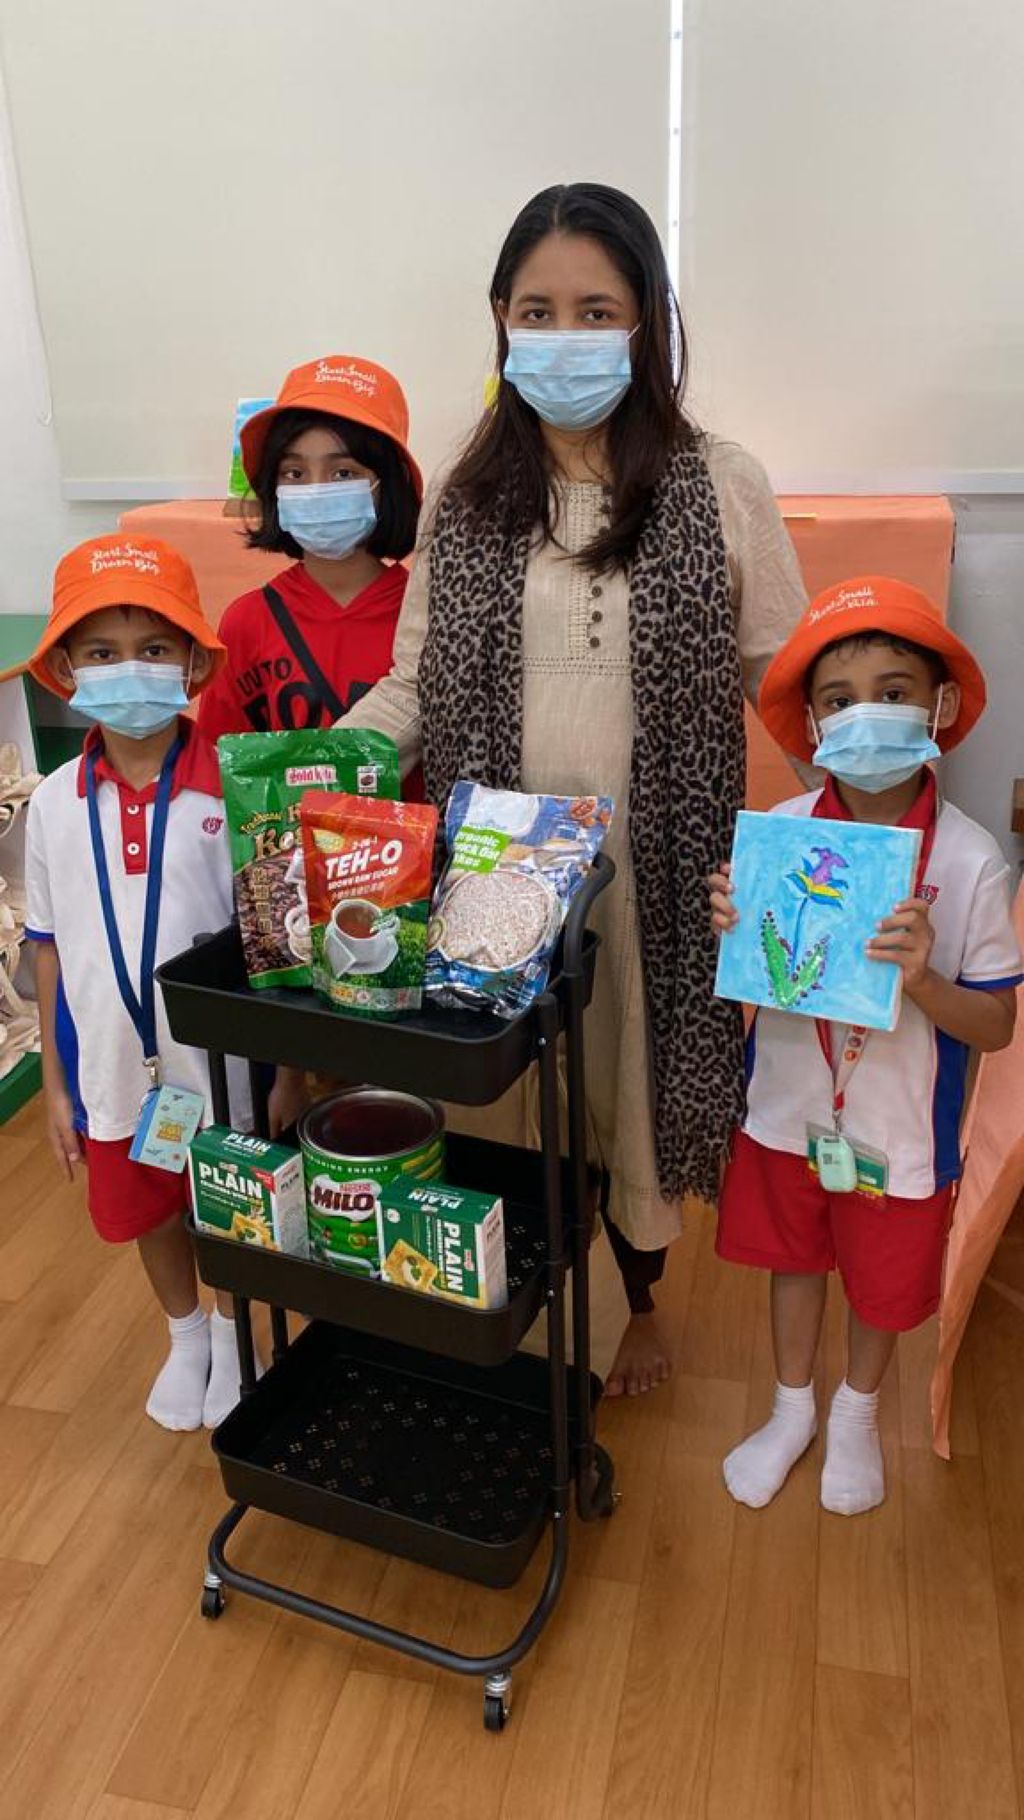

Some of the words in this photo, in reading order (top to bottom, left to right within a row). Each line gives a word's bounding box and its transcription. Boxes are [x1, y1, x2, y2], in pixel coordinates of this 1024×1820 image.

[325, 839, 403, 881] TEH-O
[225, 1132, 271, 1152] PLAIN
[199, 1162, 262, 1198] PLAIN
[347, 1165, 389, 1174] ENERGY
[314, 1185, 375, 1211] MILO
[408, 1189, 464, 1209] PLAIN
[444, 1221, 463, 1292] PLAIN
